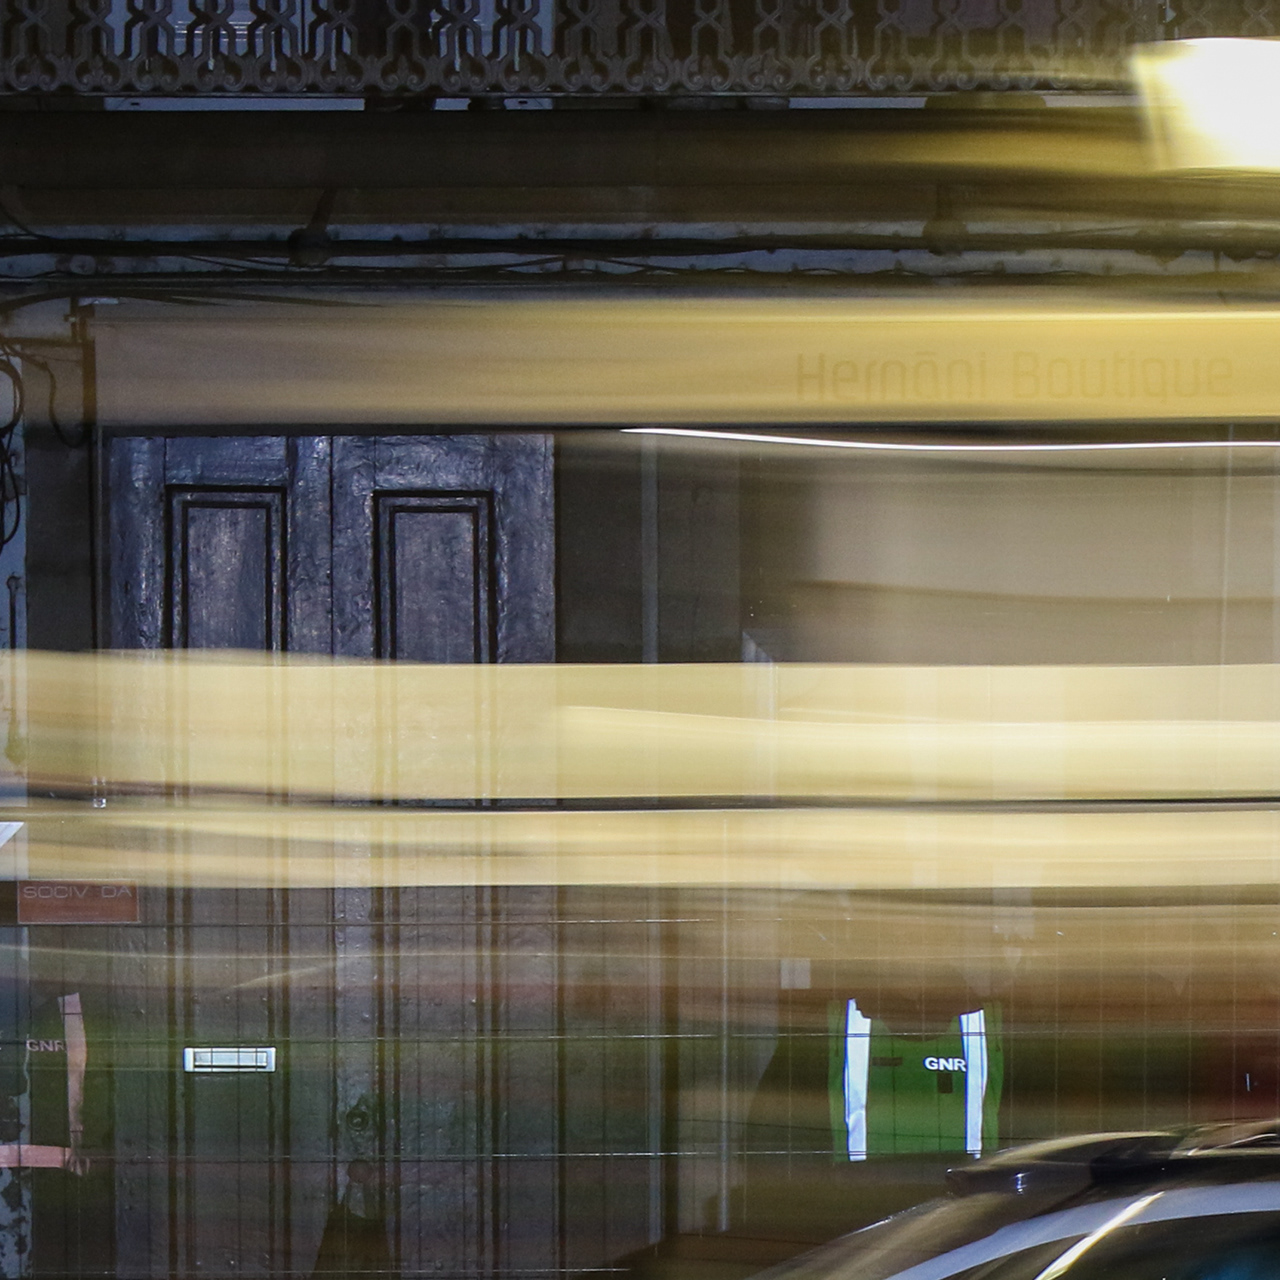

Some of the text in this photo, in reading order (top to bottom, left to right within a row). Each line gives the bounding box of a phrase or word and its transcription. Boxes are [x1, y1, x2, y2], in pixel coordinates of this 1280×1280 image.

[1011, 349, 1234, 404] Boutique
[26, 1039, 65, 1052] GNR
[924, 1057, 967, 1072] GNR
